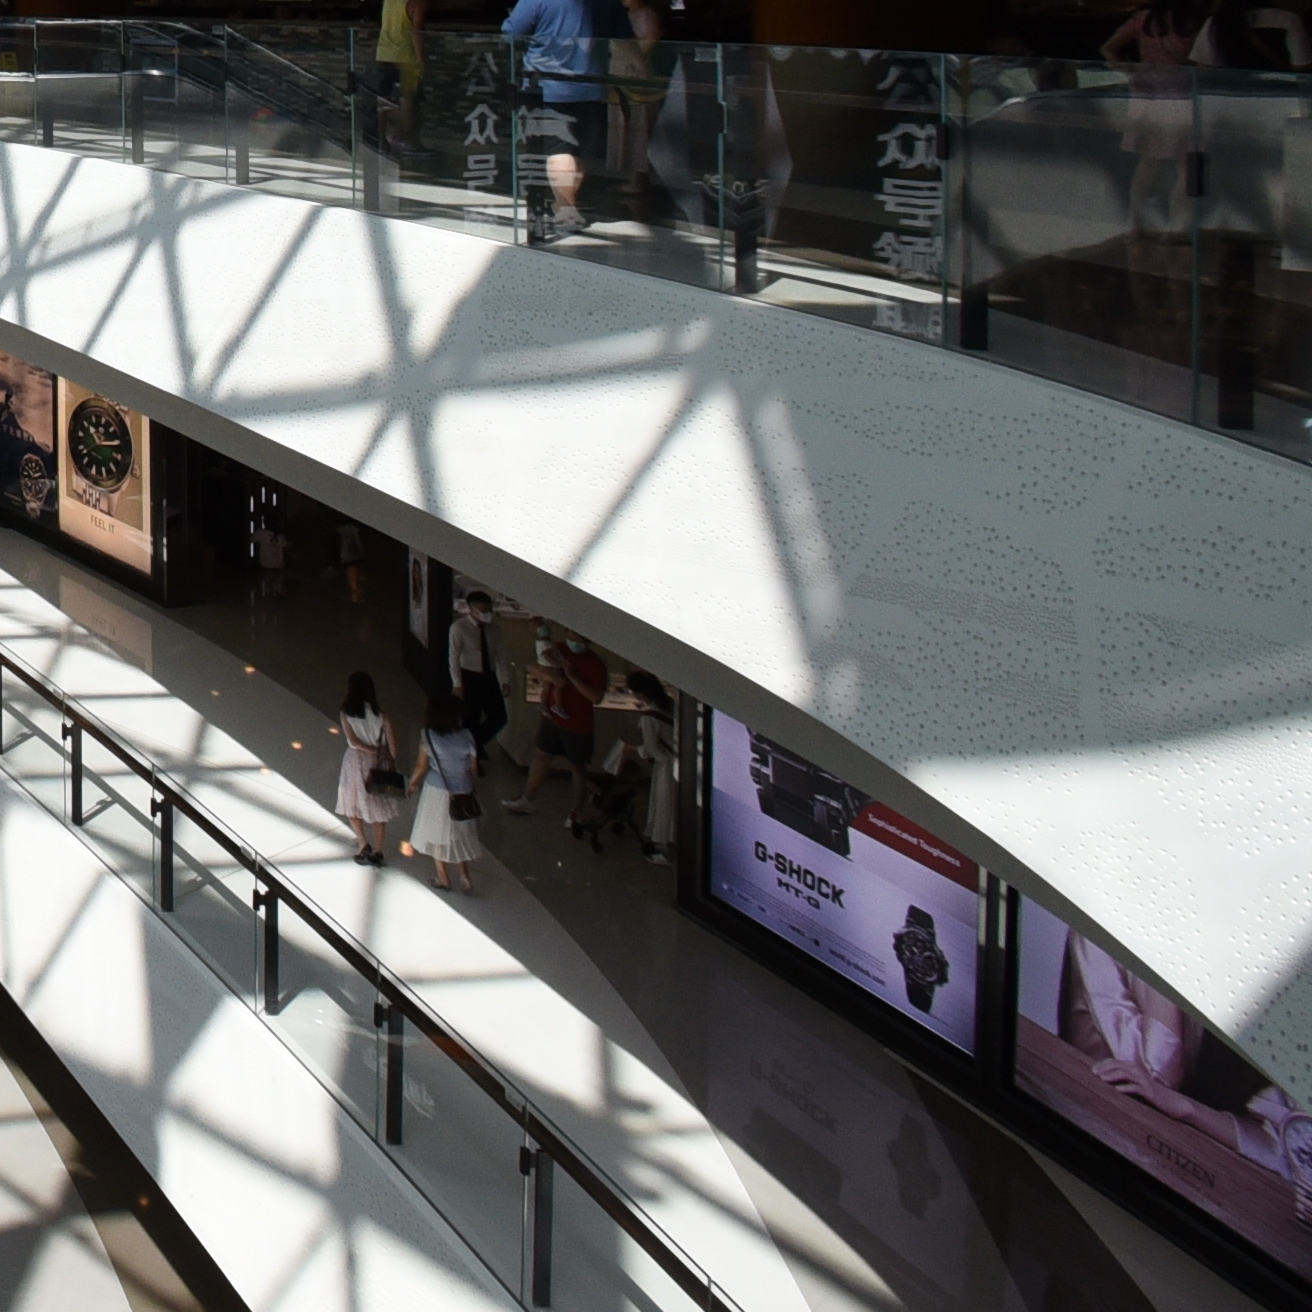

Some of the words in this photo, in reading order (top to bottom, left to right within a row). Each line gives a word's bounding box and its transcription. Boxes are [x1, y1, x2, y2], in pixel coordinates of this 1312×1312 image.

[90, 514, 107, 532] FEEL
[754, 839, 846, 910] G-SHOCK
[1146, 1134, 1216, 1188] CITIZEN
